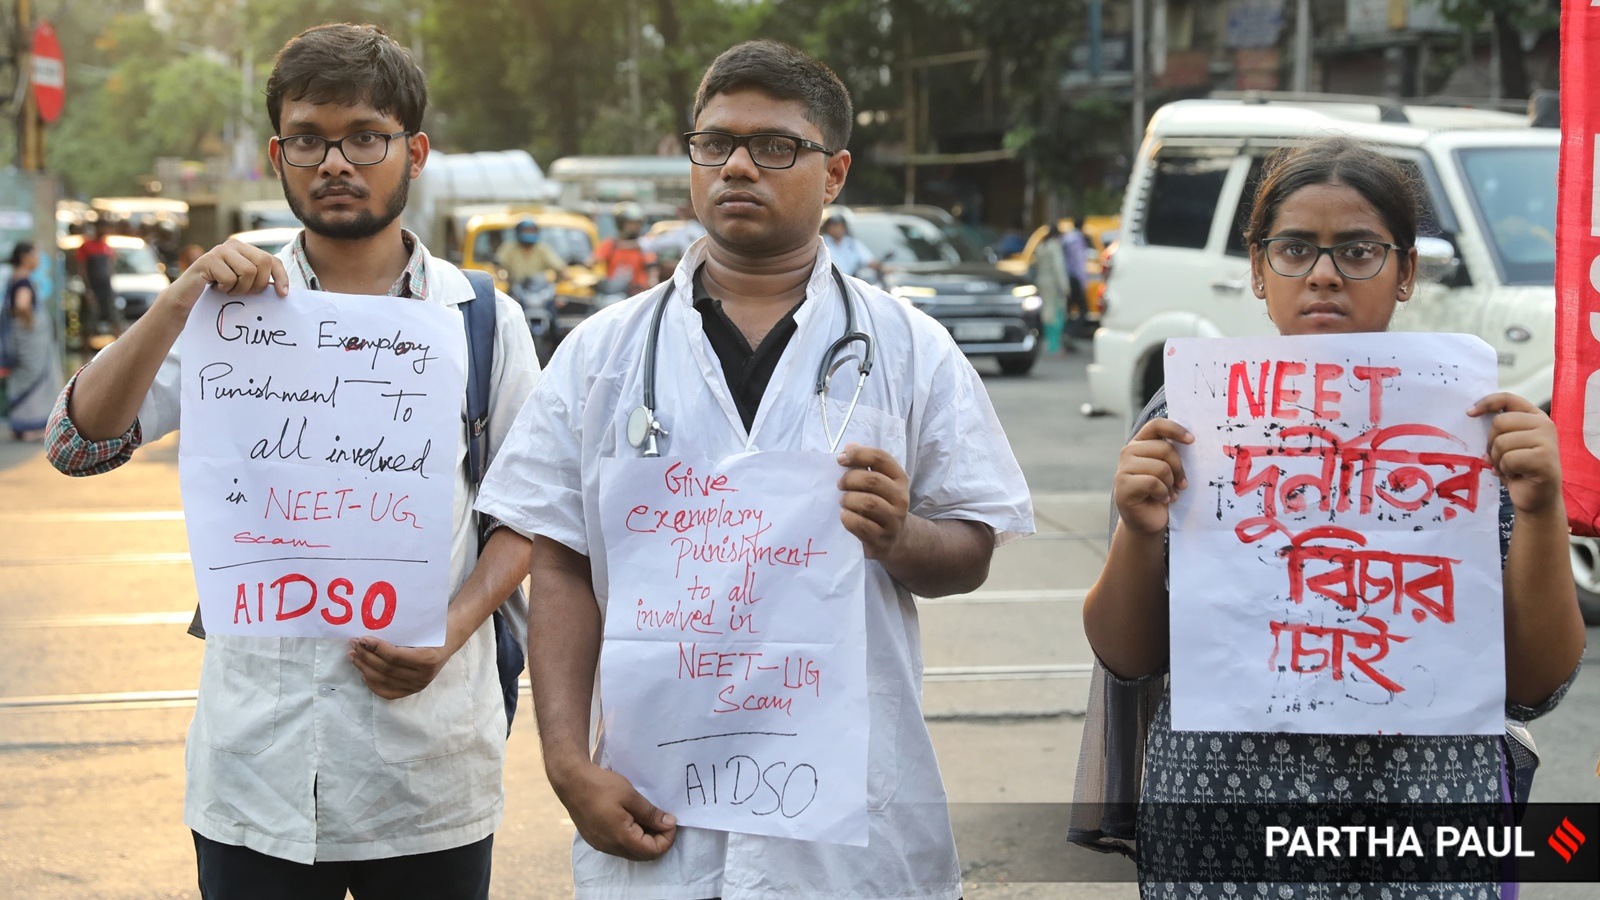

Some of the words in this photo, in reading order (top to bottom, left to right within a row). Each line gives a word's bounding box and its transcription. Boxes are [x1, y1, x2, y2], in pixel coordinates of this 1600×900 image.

[216, 301, 297, 346] Give
[199, 362, 391, 408] Punishment
[1227, 359, 1401, 423] NEET
[250, 416, 311, 459] all
[325, 435, 430, 479] involved
[226, 478, 248, 504] in
[264, 487, 423, 529] NEET-UG
[665, 462, 739, 496] Give
[687, 575, 710, 601] to
[728, 567, 763, 605] all
[1276, 526, 1463, 624] বিচার
[234, 573, 397, 631] AIDSO
[636, 598, 723, 634] involved
[730, 605, 760, 633] in
[678, 642, 820, 697] NEET-UG
[685, 755, 818, 818] AIDSO
